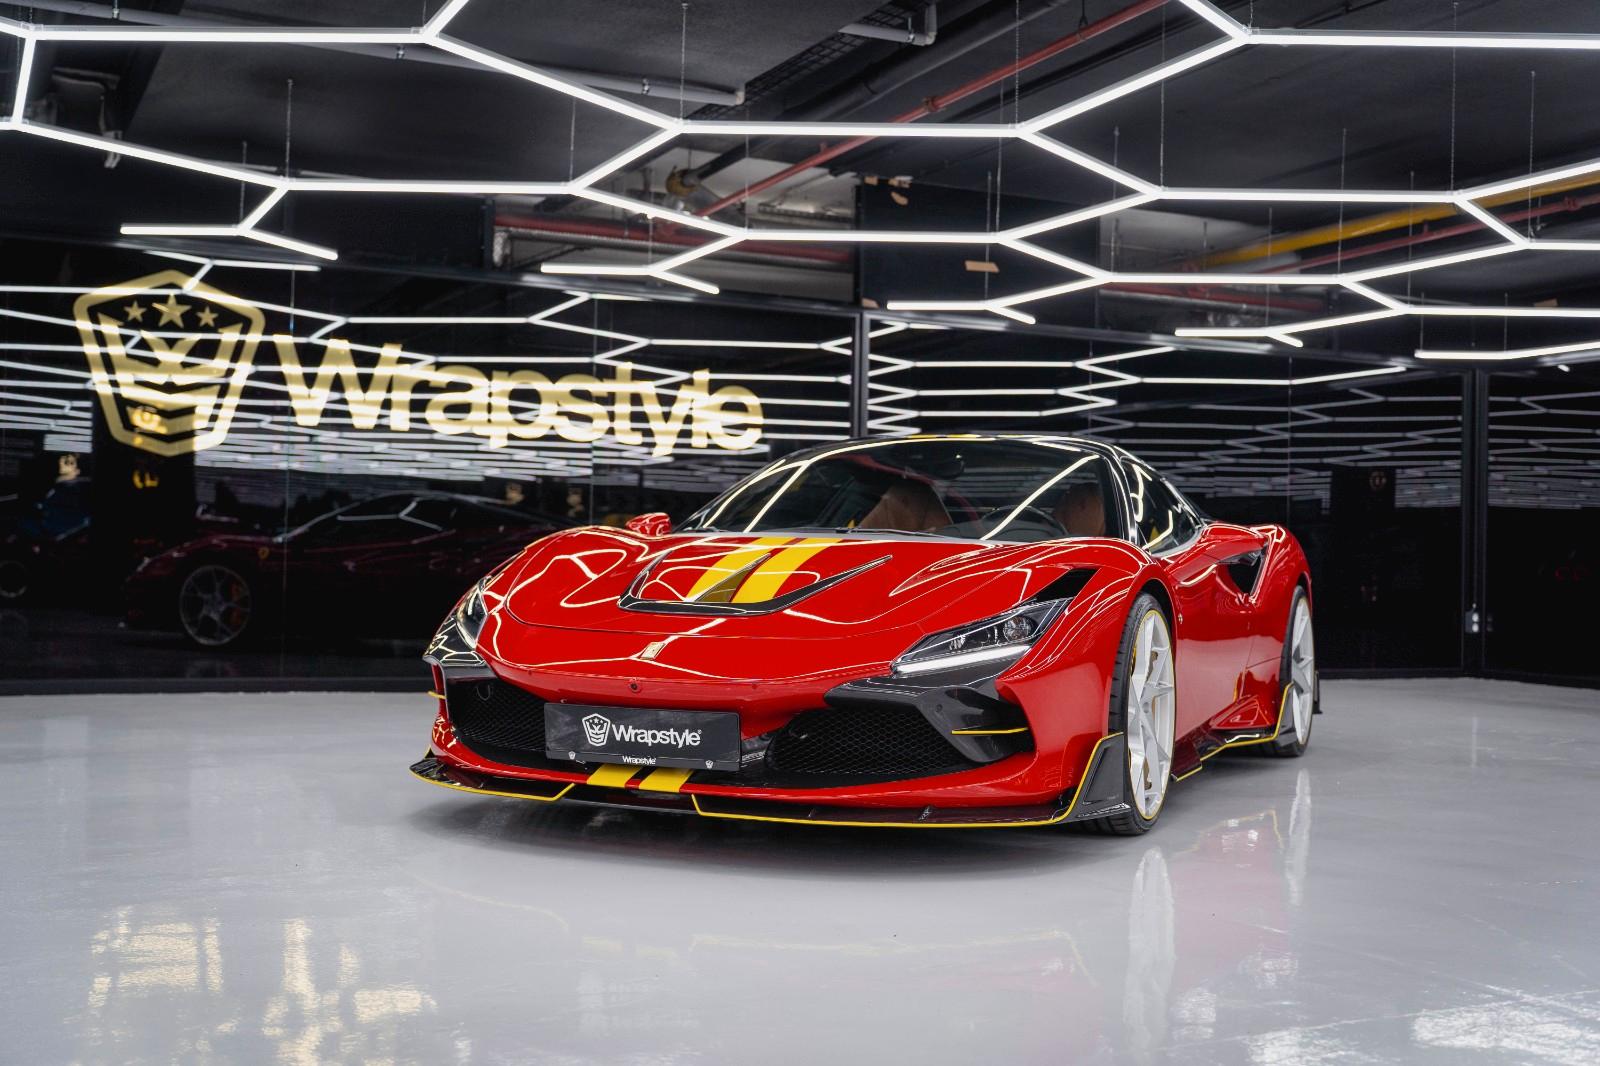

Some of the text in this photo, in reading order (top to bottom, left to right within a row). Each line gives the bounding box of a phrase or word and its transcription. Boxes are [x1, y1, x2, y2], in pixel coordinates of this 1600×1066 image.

[273, 334, 764, 457] Wrapstyle
[612, 724, 701, 748] Wrapstyle
[622, 755, 656, 765] Wrapstyle
